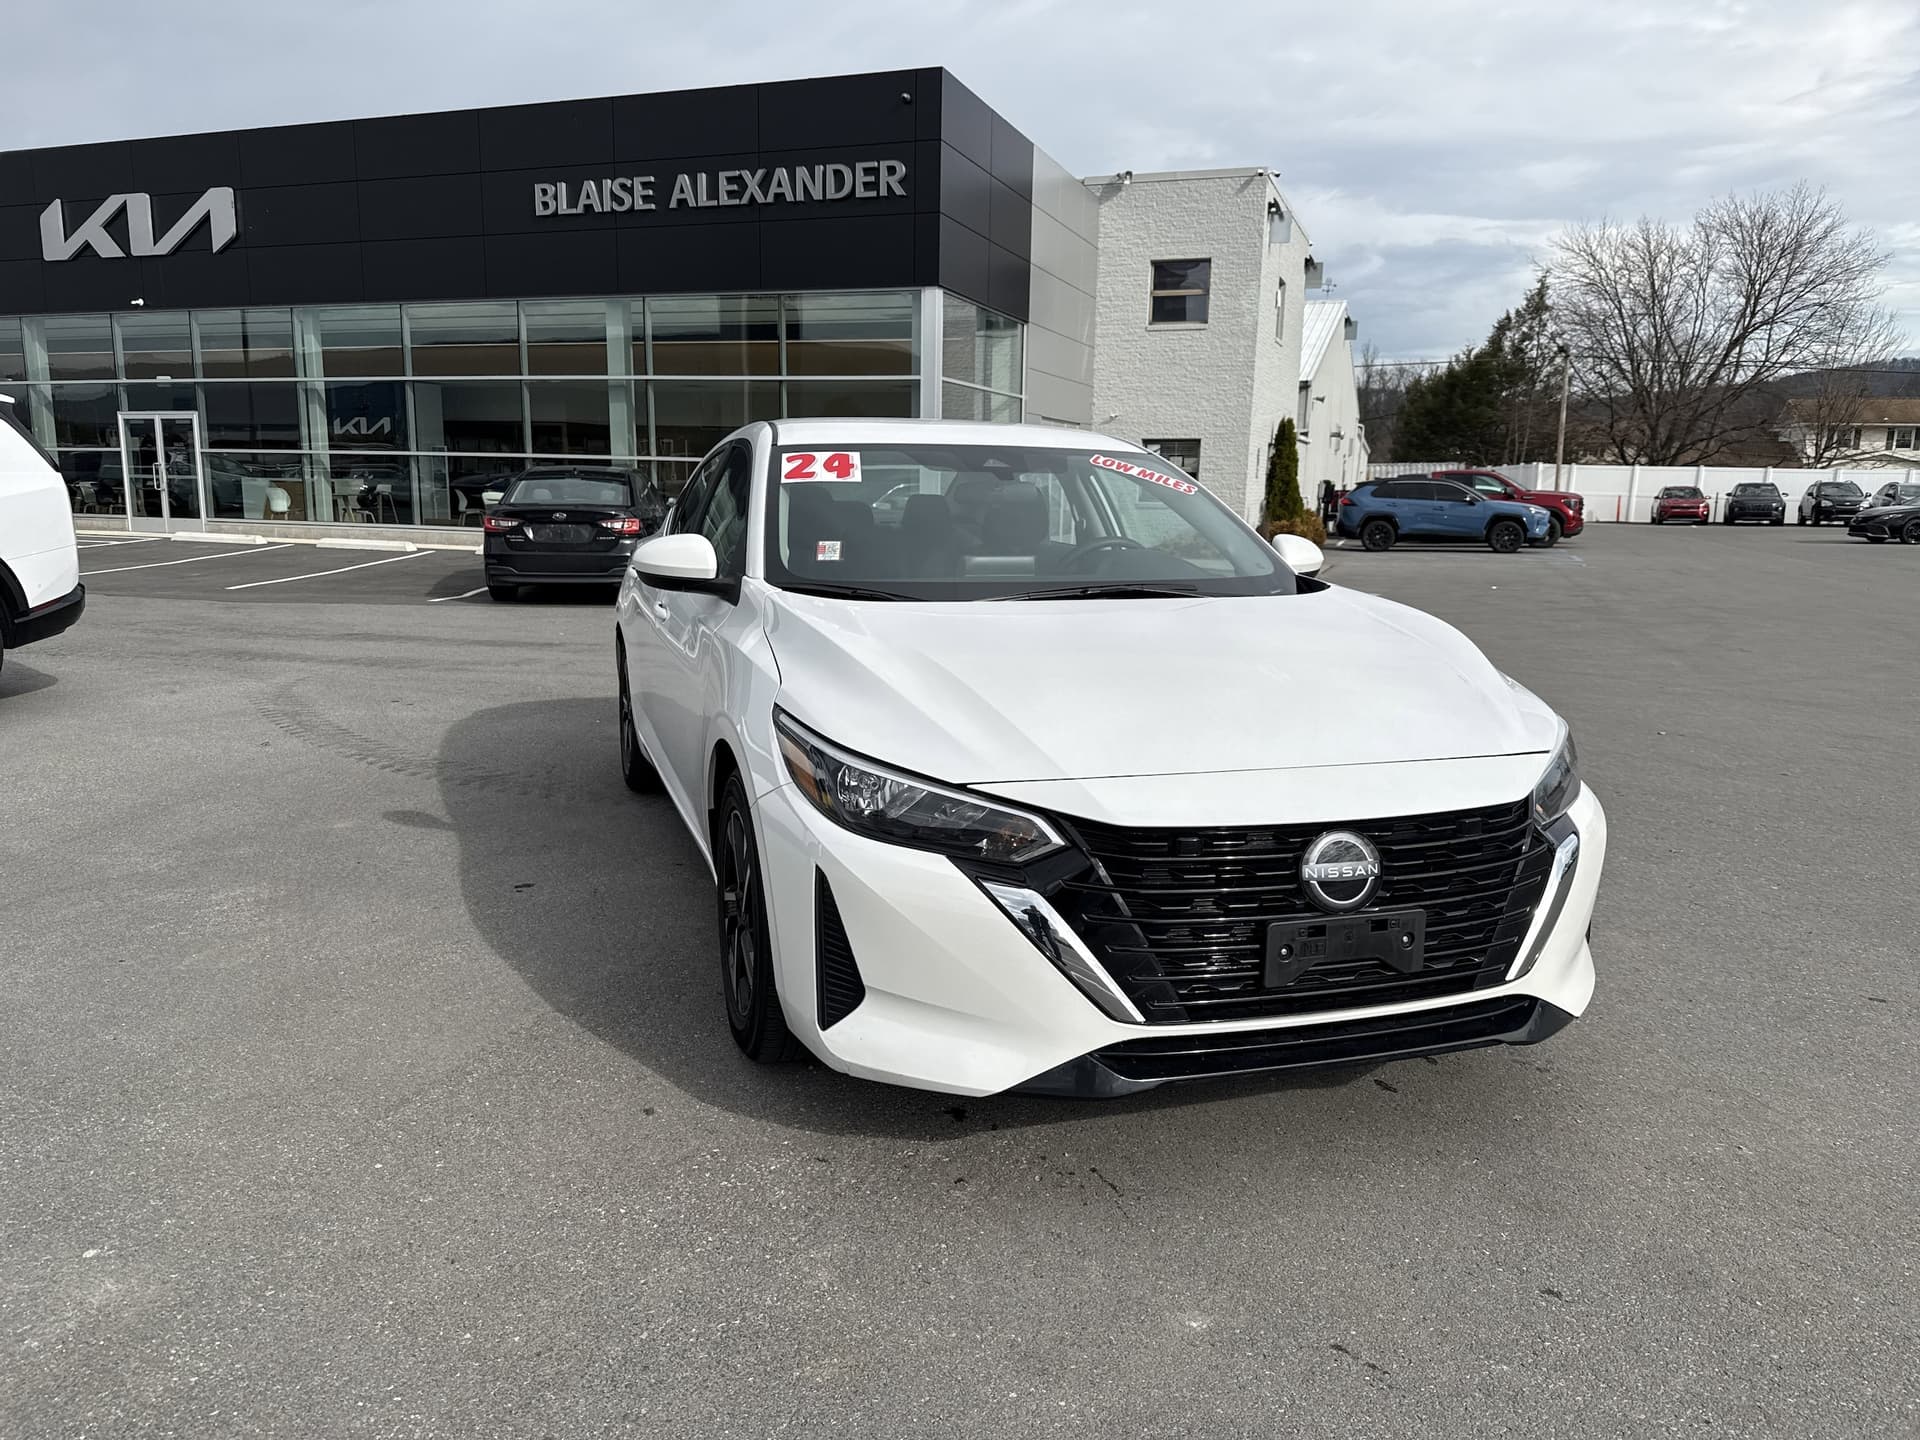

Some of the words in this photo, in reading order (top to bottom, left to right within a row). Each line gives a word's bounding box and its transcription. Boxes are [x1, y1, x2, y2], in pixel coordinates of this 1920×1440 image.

[534, 176, 655, 216] BLAISE
[669, 160, 907, 208] ALEXANDER
[40, 187, 236, 261] KIA
[333, 416, 391, 435] KIA
[784, 453, 855, 479] 24
[1091, 455, 1135, 473] LOW
[1137, 467, 1196, 494] MILES
[1305, 863, 1378, 878] NISSAN
